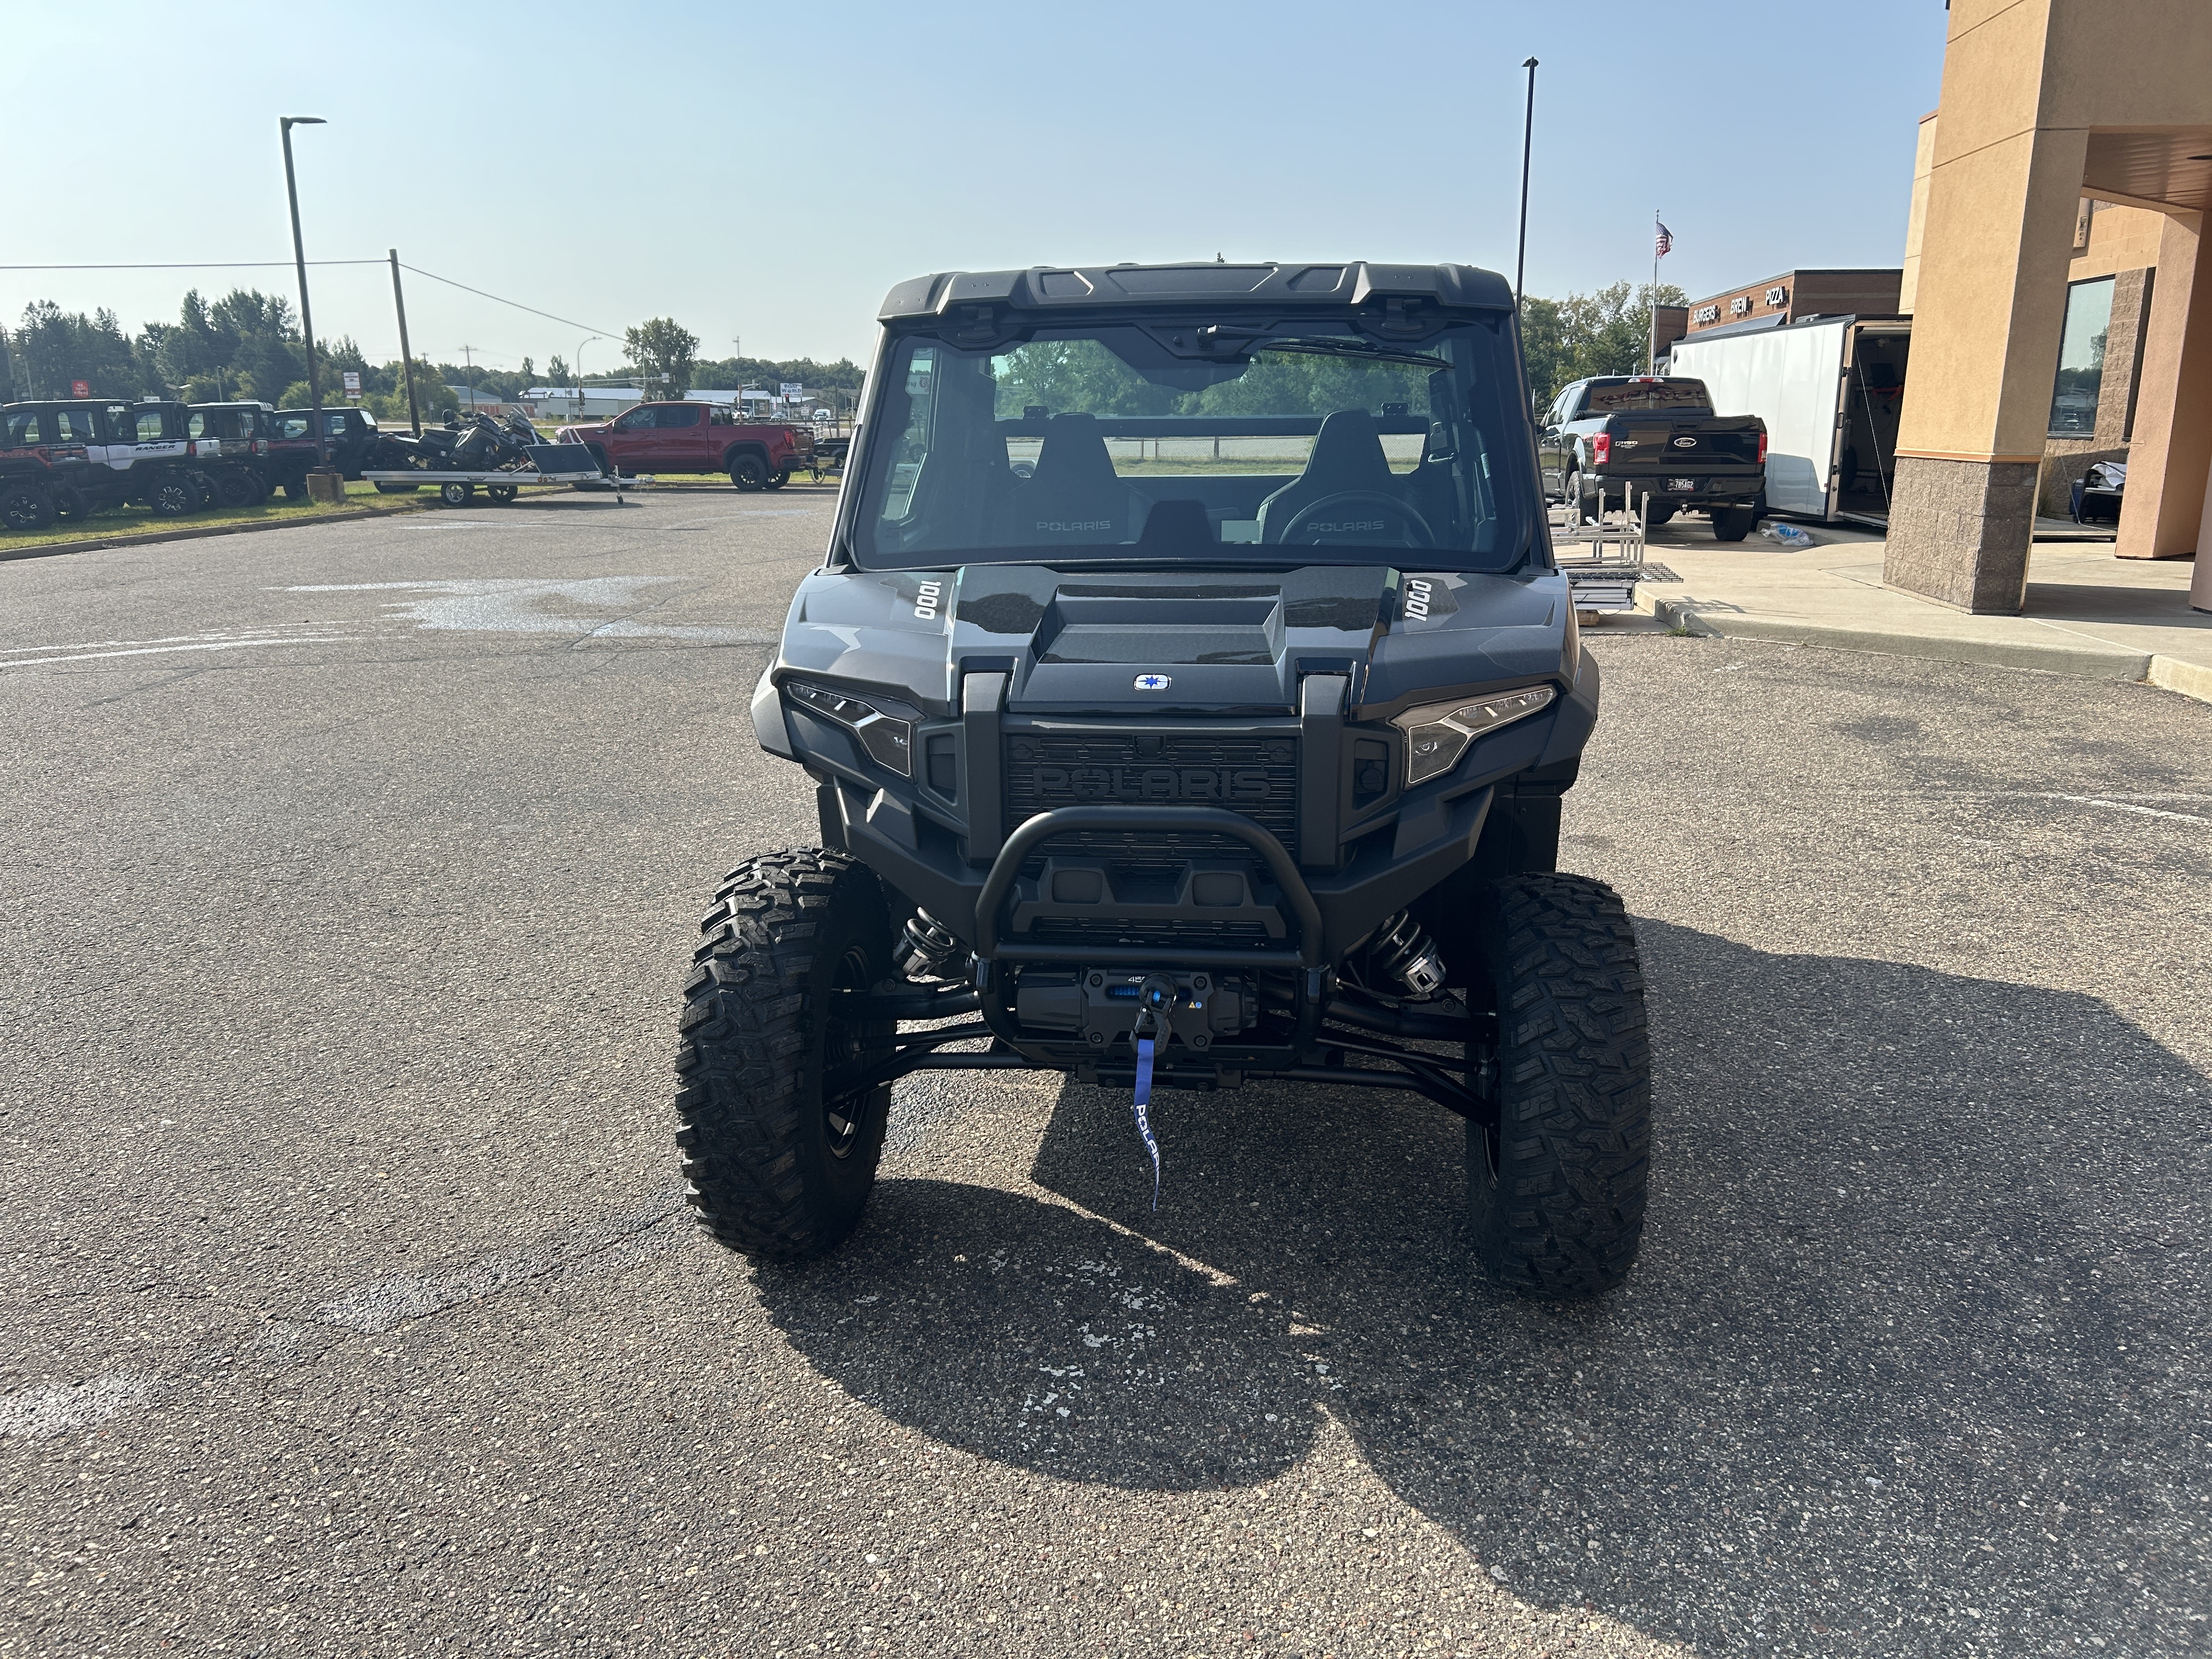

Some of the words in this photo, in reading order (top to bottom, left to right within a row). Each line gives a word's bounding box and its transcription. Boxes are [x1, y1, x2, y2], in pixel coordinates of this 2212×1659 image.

[1693, 304, 1716, 324] BURGERS
[1730, 296, 1747, 315] BREW
[1765, 286, 1783, 306] PIZZA
[1036, 521, 1111, 531] POLARIS
[1307, 521, 1385, 532] POLARIS
[914, 580, 941, 620] 1000
[1404, 580, 1432, 622] 1000
[1033, 769, 1271, 798] POLARIS
